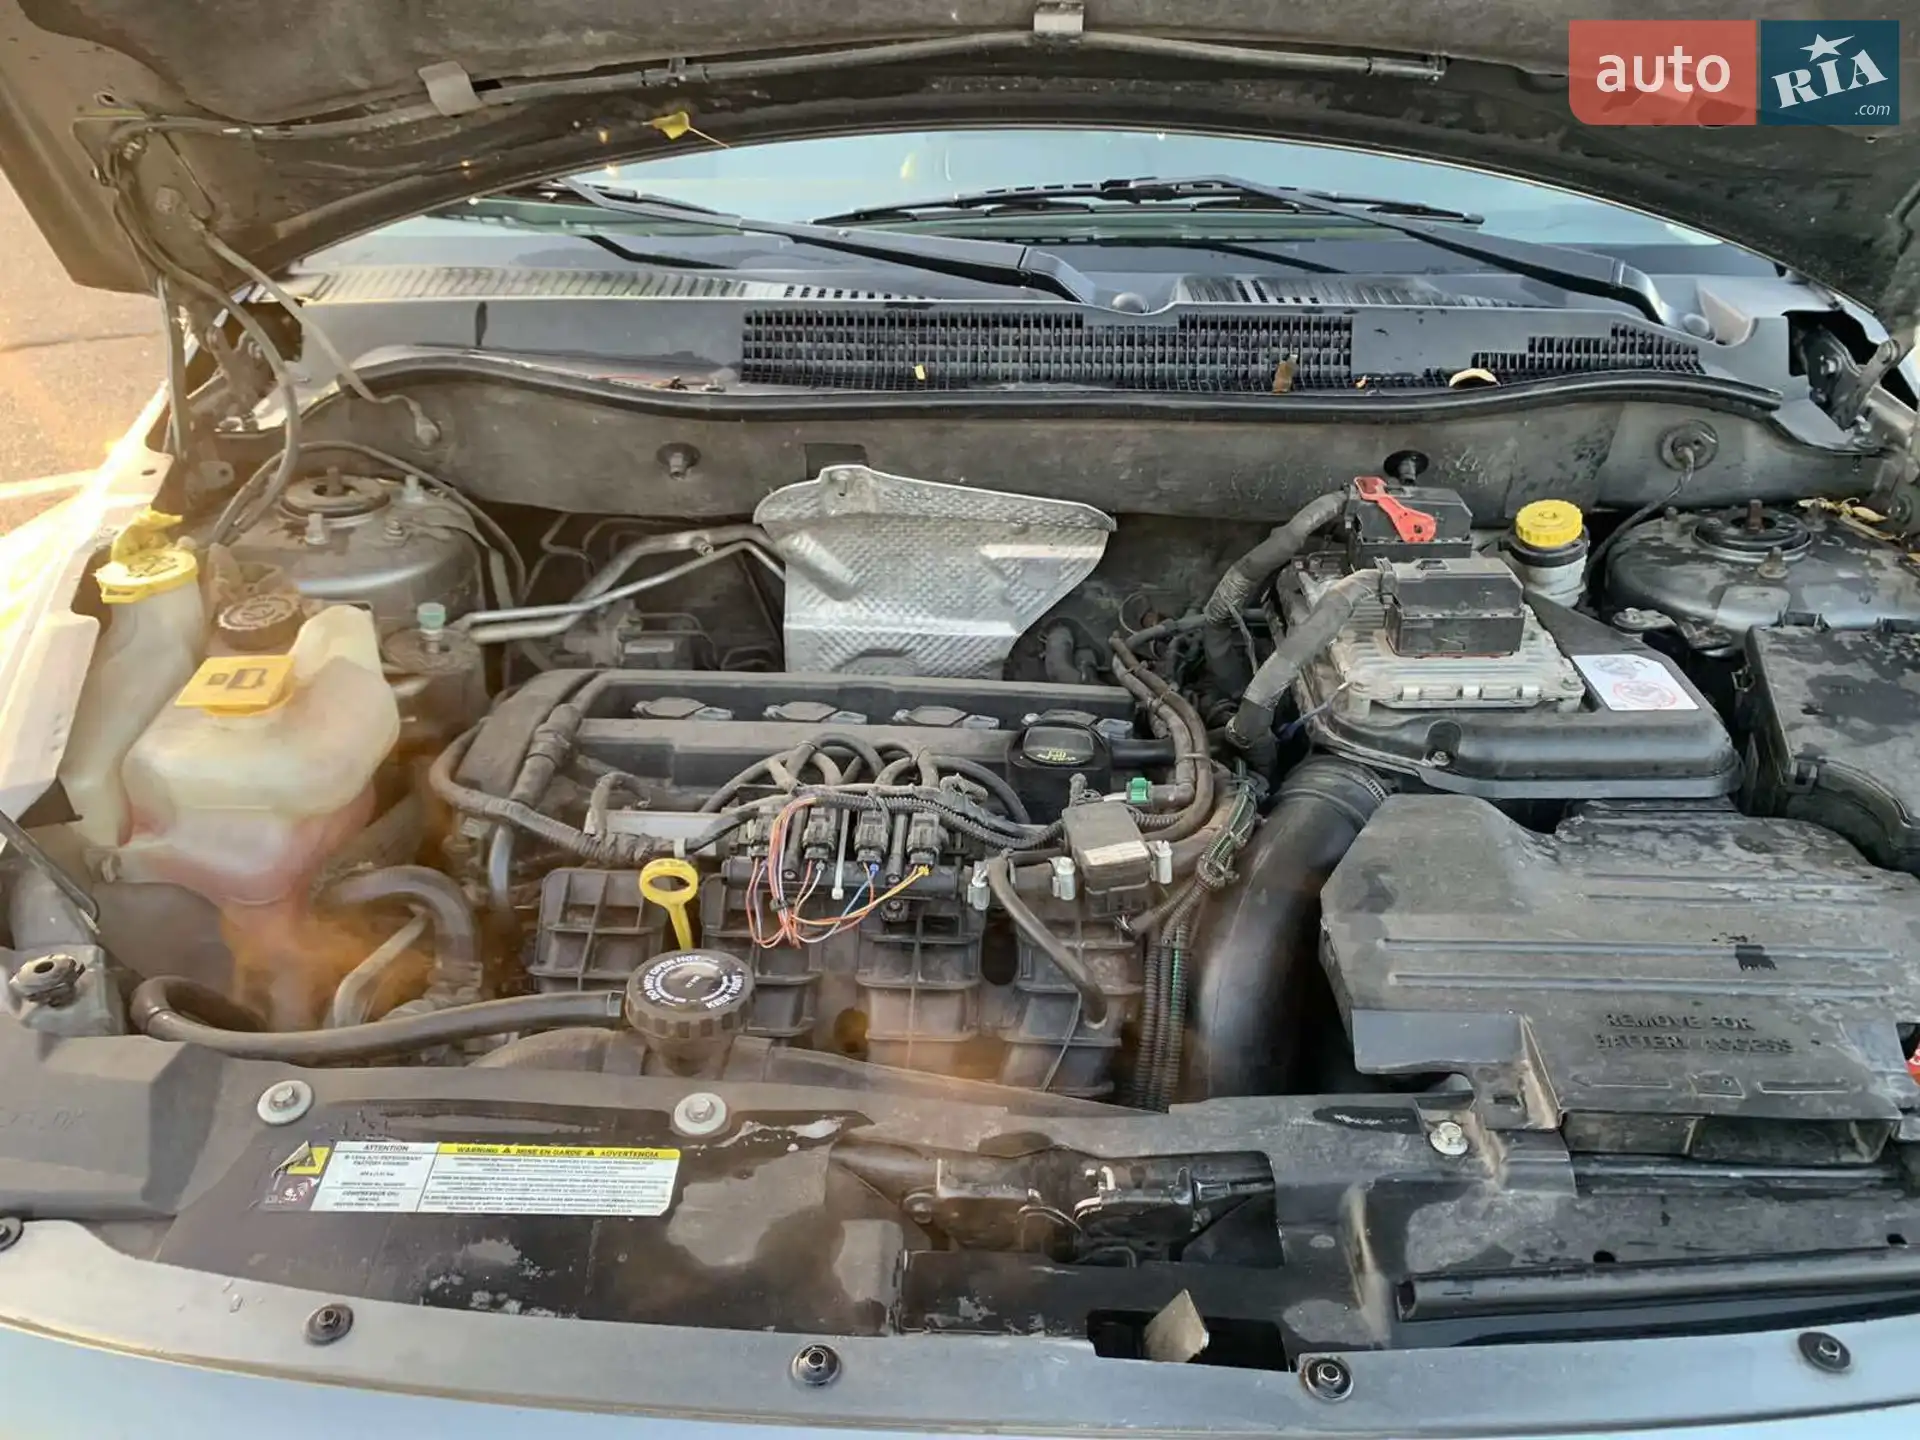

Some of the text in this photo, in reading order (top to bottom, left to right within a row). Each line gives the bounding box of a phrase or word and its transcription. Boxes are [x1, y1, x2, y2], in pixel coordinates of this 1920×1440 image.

[649, 958, 677, 976] OPEN
[676, 955, 701, 964] HOT
[704, 992, 731, 1009] KEEP
[1605, 1013, 1756, 1032] REMOVE FOR
[1595, 1033, 1794, 1053] BATTERY ACCESS
[363, 1143, 411, 1152] ATTENTION
[456, 1146, 499, 1154] WARNING
[552, 1149, 582, 1157] GARDE
[599, 1150, 660, 1159] ADVERTENCIA
